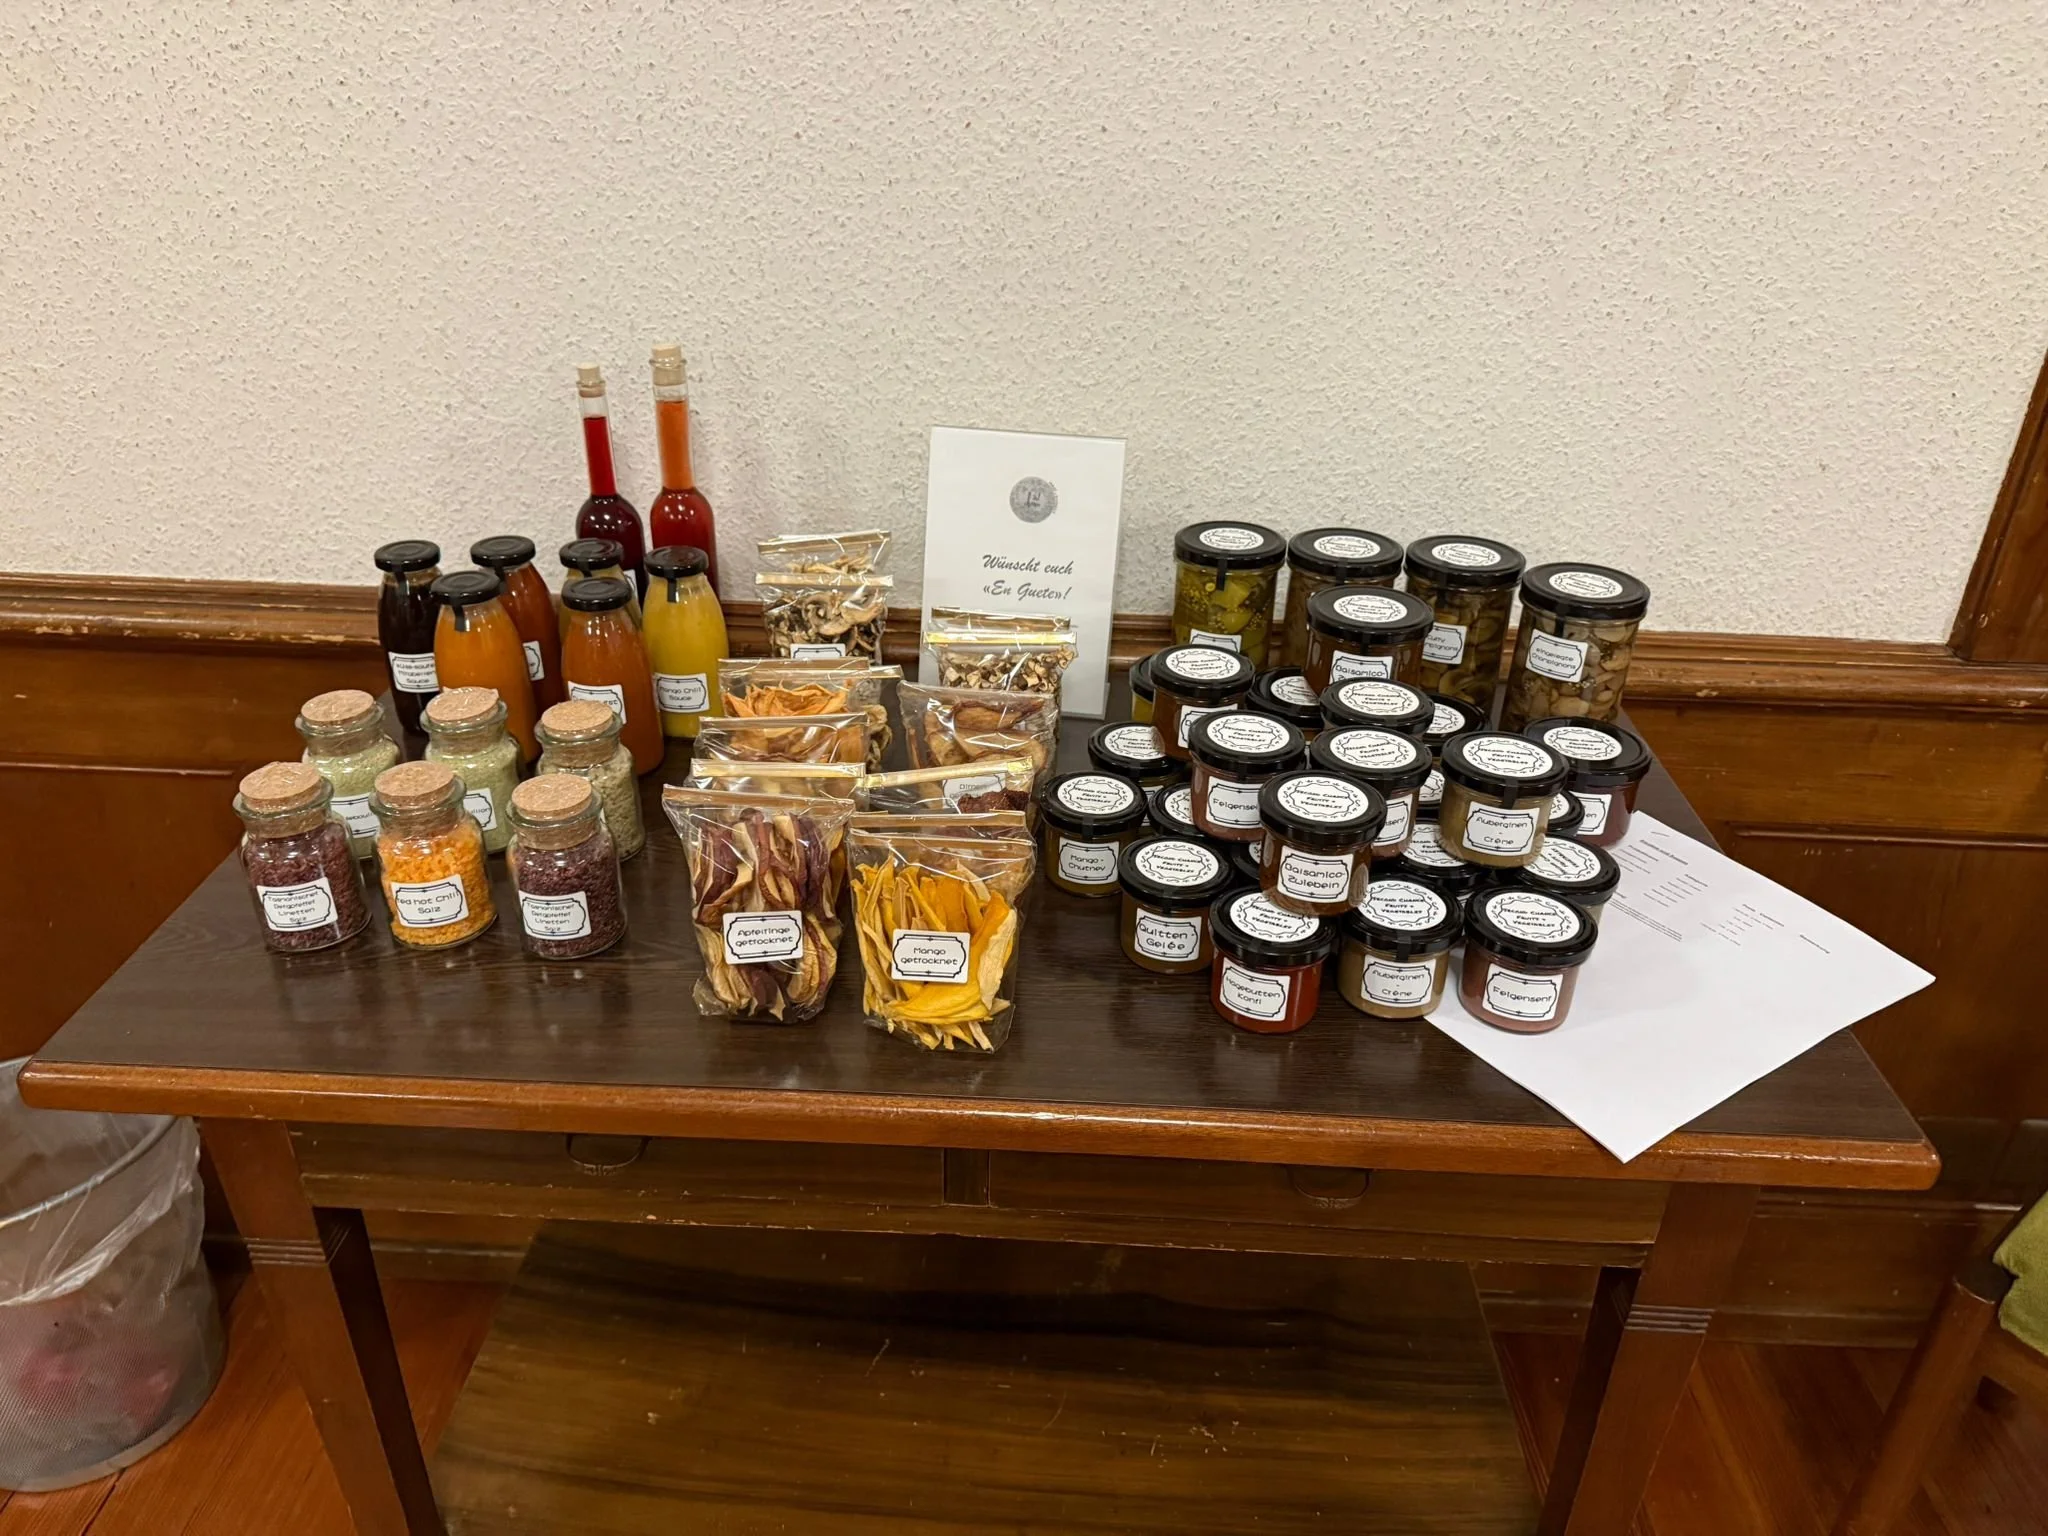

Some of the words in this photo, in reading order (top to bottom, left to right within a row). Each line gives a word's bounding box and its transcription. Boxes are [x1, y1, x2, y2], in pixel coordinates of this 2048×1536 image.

[982, 554, 1040, 573] Wünscht
[1044, 560, 1074, 575] euch
[983, 579, 1012, 596] «En
[1017, 582, 1072, 601] Guete»!
[1335, 664, 1386, 677] Balsamico-
[1476, 816, 1528, 829] Auberginen
[1070, 854, 1099, 864] Mango
[1068, 862, 1106, 872] Chutney
[1284, 862, 1346, 879] Balsamico-
[417, 906, 441, 914] Salz
[737, 927, 791, 937] Apfelringe
[1139, 923, 1188, 939] Quitten
[735, 936, 794, 947] getrocknet
[1146, 938, 1185, 950] Gelée
[913, 947, 946, 955] Mango
[900, 957, 958, 966] getrocknet
[1372, 969, 1425, 981] Auberginen
[1237, 992, 1262, 1005] Konfi
[1493, 985, 1552, 1003] Feigensenf
